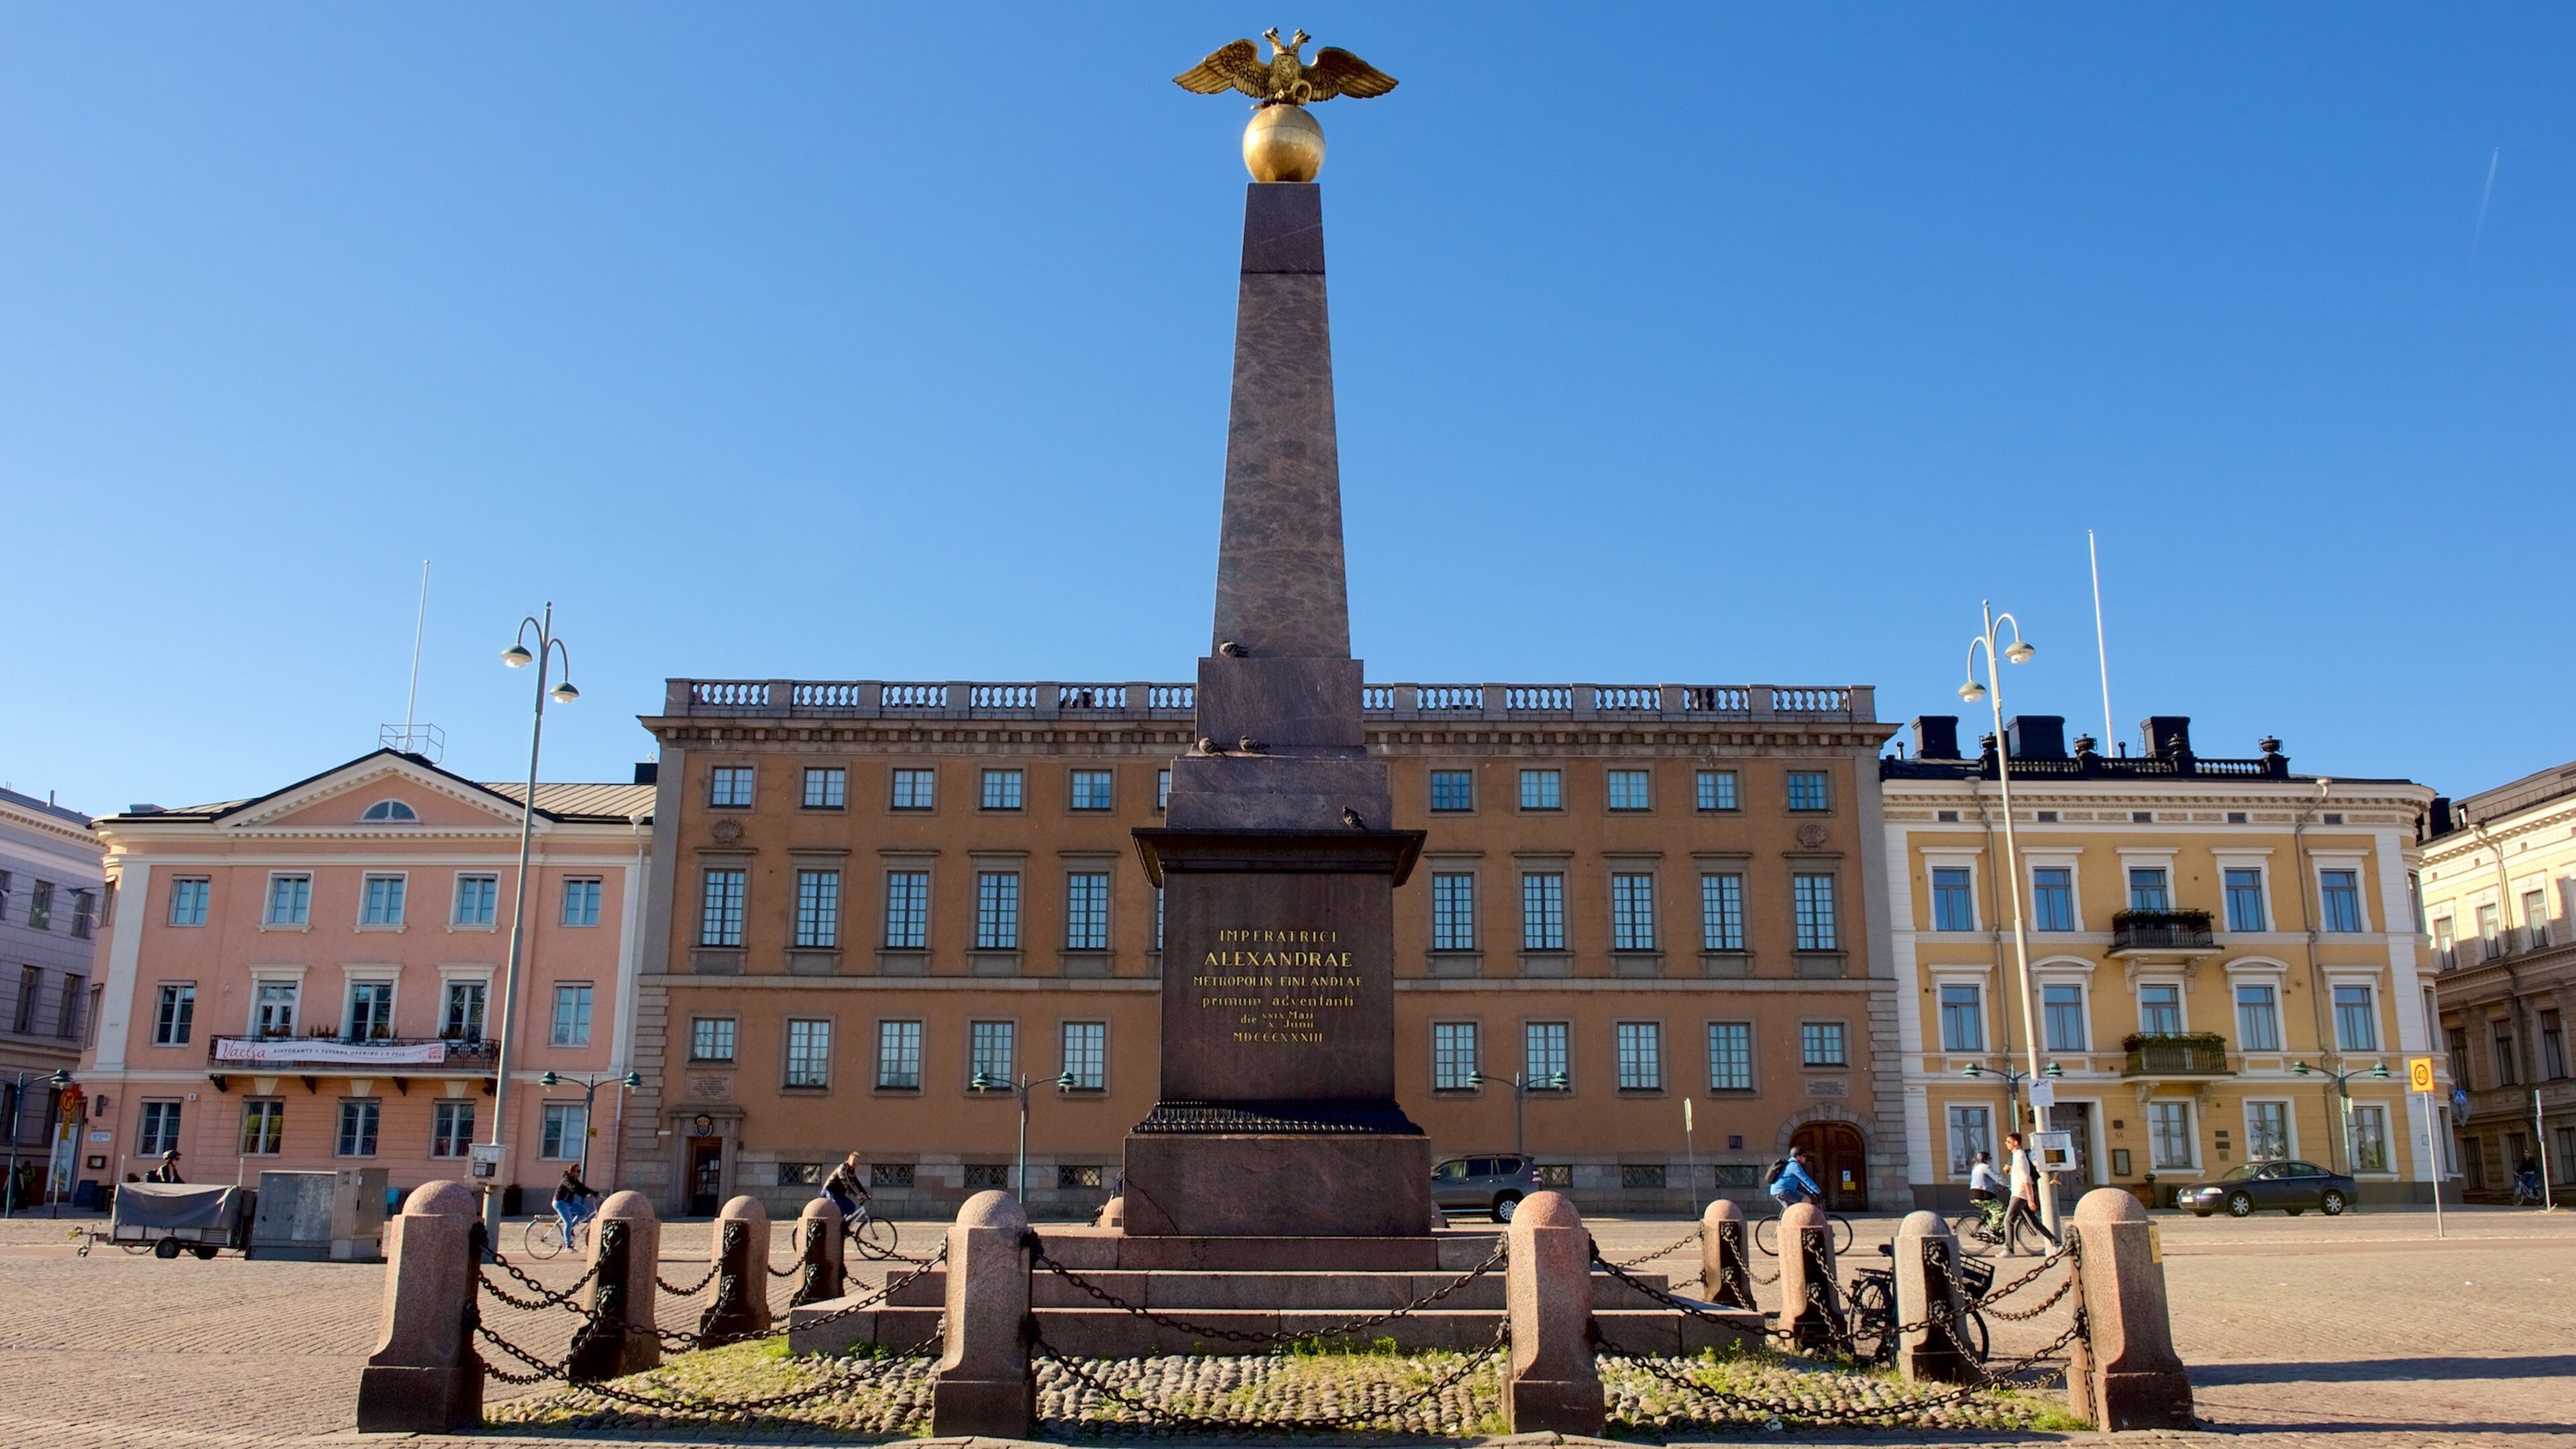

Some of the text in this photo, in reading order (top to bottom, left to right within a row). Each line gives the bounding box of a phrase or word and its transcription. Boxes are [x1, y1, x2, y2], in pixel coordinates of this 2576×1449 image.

[1219, 930, 1336, 943] IMPERATRICI
[1203, 951, 1352, 967] ALEXANDRAE
[1193, 975, 1364, 987] METROPOLIN FINLANDIAE
[1202, 994, 1354, 1009] primum adventanti
[1240, 1014, 1258, 1024] die
[1283, 1018, 1313, 1028] Junii
[1233, 1032, 1323, 1042] MDCCCXXXIII
[2417, 1069, 2426, 1080] 40
[1826, 1106, 1831, 1114] 7
